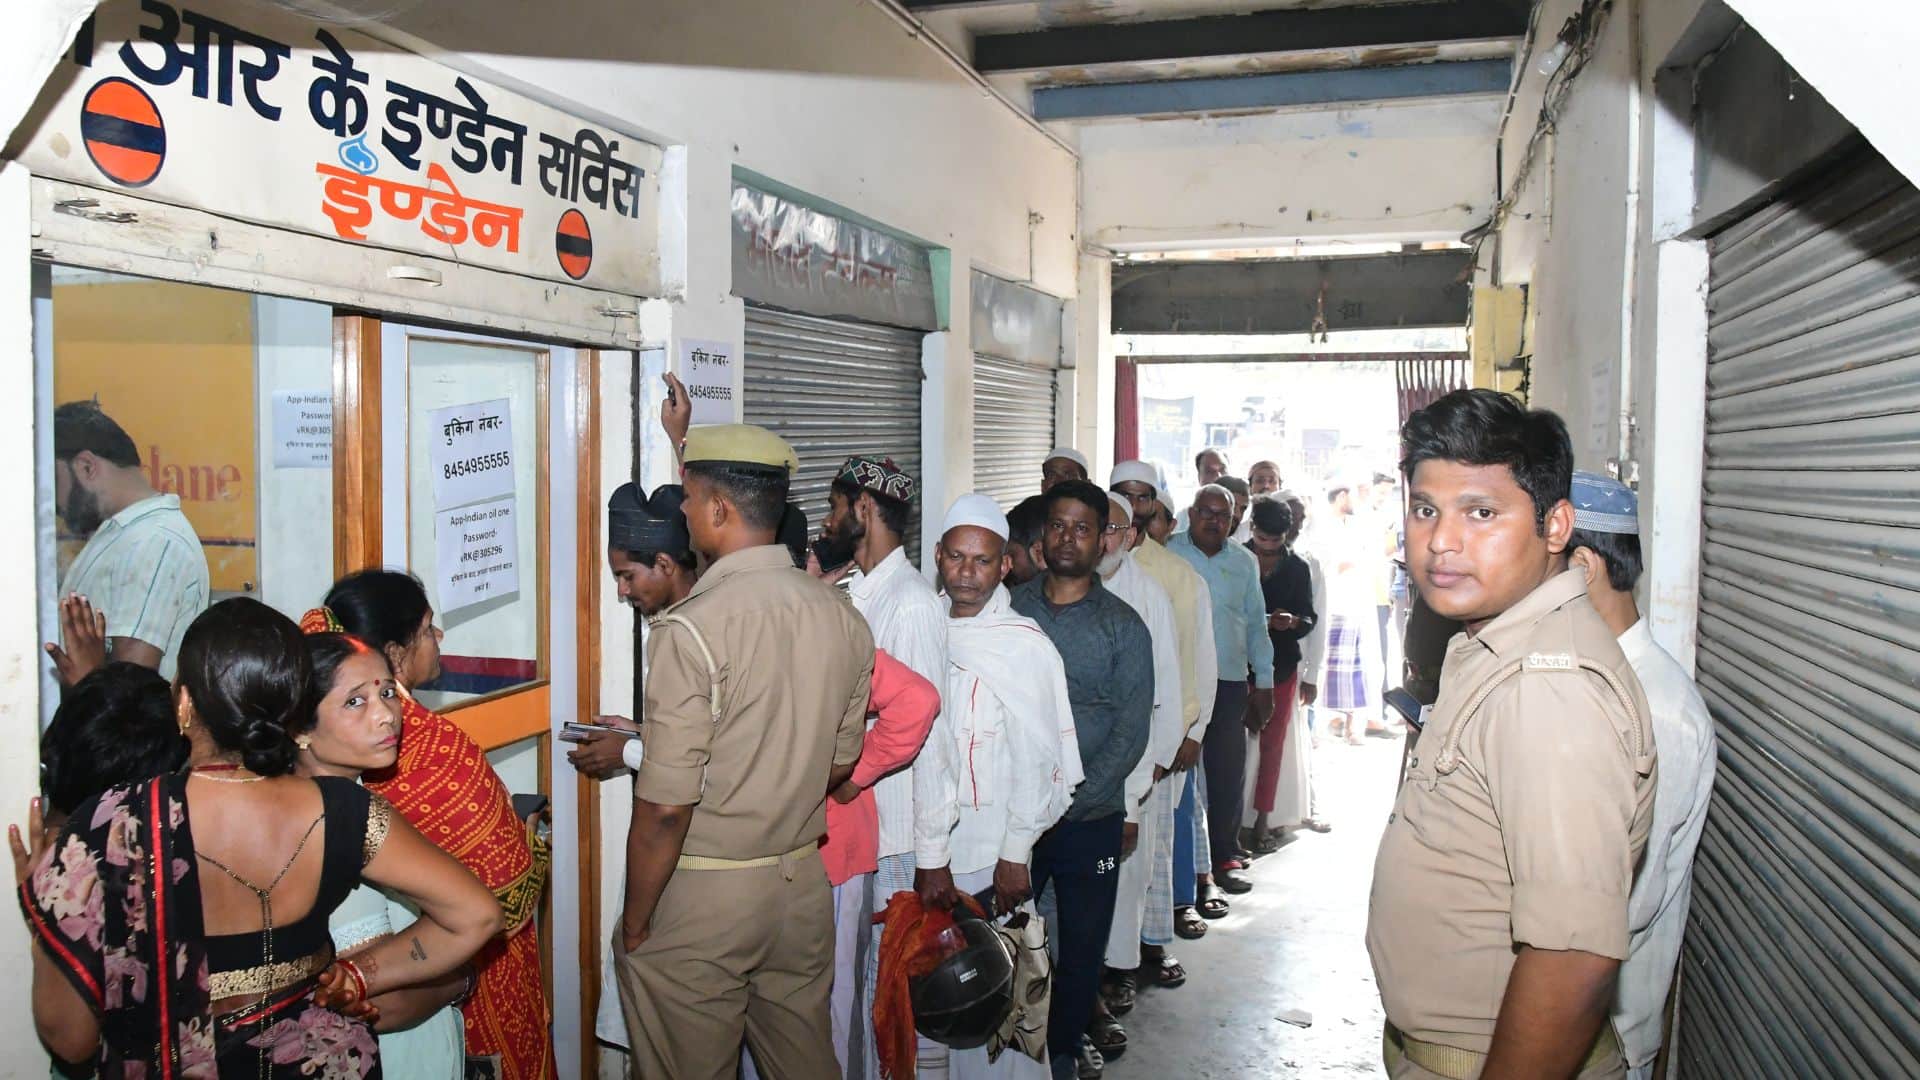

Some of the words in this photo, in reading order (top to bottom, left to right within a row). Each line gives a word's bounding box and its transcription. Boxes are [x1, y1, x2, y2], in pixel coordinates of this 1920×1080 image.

[118, 0, 291, 121] आर
[308, 27, 369, 138] के
[380, 77, 528, 185] इण्डेन
[538, 129, 645, 219] सर्विस
[315, 162, 524, 254] इण्डेन
[689, 384, 732, 400] 8454955555
[301, 411, 331, 420] Passwor
[443, 415, 474, 446] बुकिंग
[142, 445, 242, 502] dane
[443, 450, 510, 479] 8454955555
